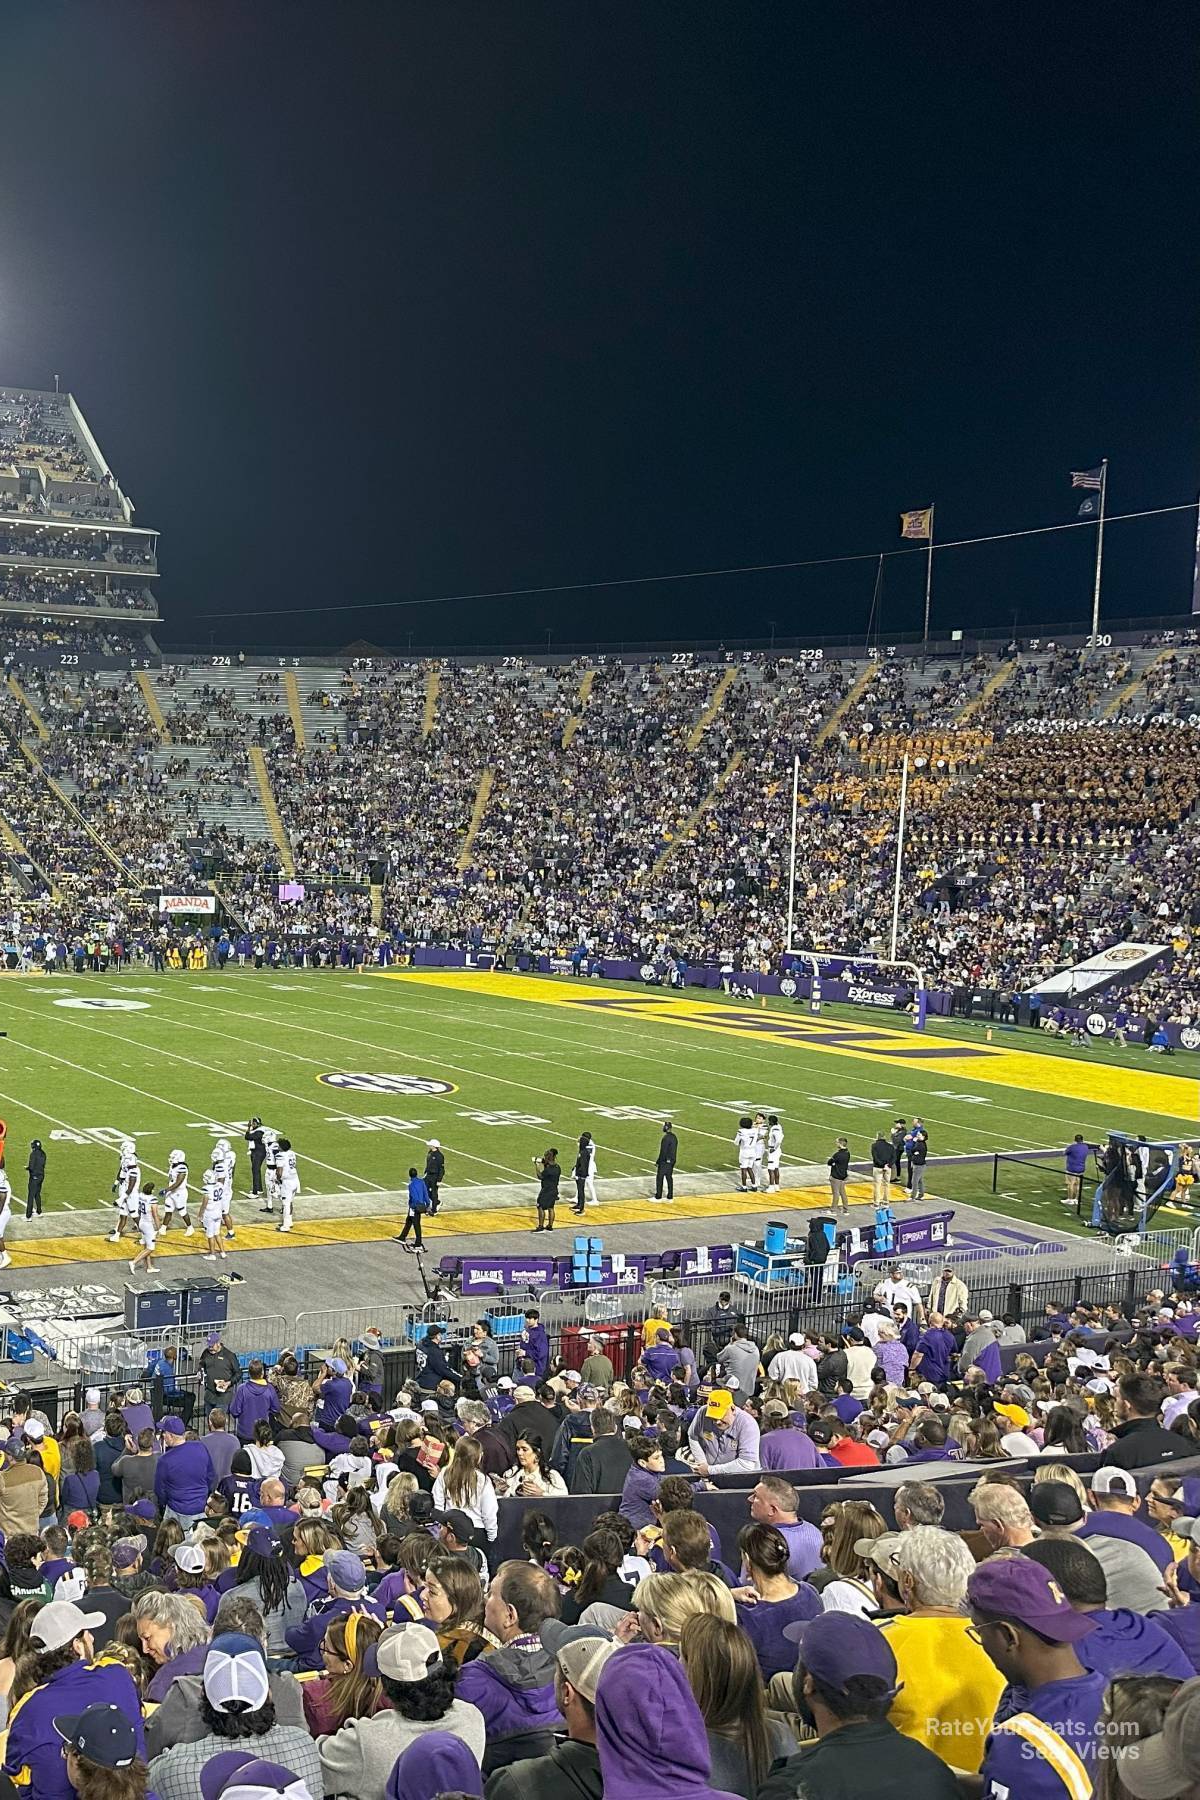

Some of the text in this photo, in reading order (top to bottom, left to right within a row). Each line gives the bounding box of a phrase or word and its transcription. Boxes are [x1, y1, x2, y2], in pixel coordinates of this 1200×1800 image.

[1086, 635, 1112, 647] 230
[672, 653, 693, 663] 227
[800, 649, 824, 659] 228
[60, 655, 79, 665] 223
[212, 657, 231, 666] 224
[165, 897, 209, 909] MANDA
[1088, 1019, 1104, 1029] 44
[324, 1115, 423, 1131] 30
[49, 1127, 136, 1144] 40
[749, 1136, 755, 1146] 7
[213, 1187, 224, 1202] 92
[231, 1492, 253, 1514] 16
